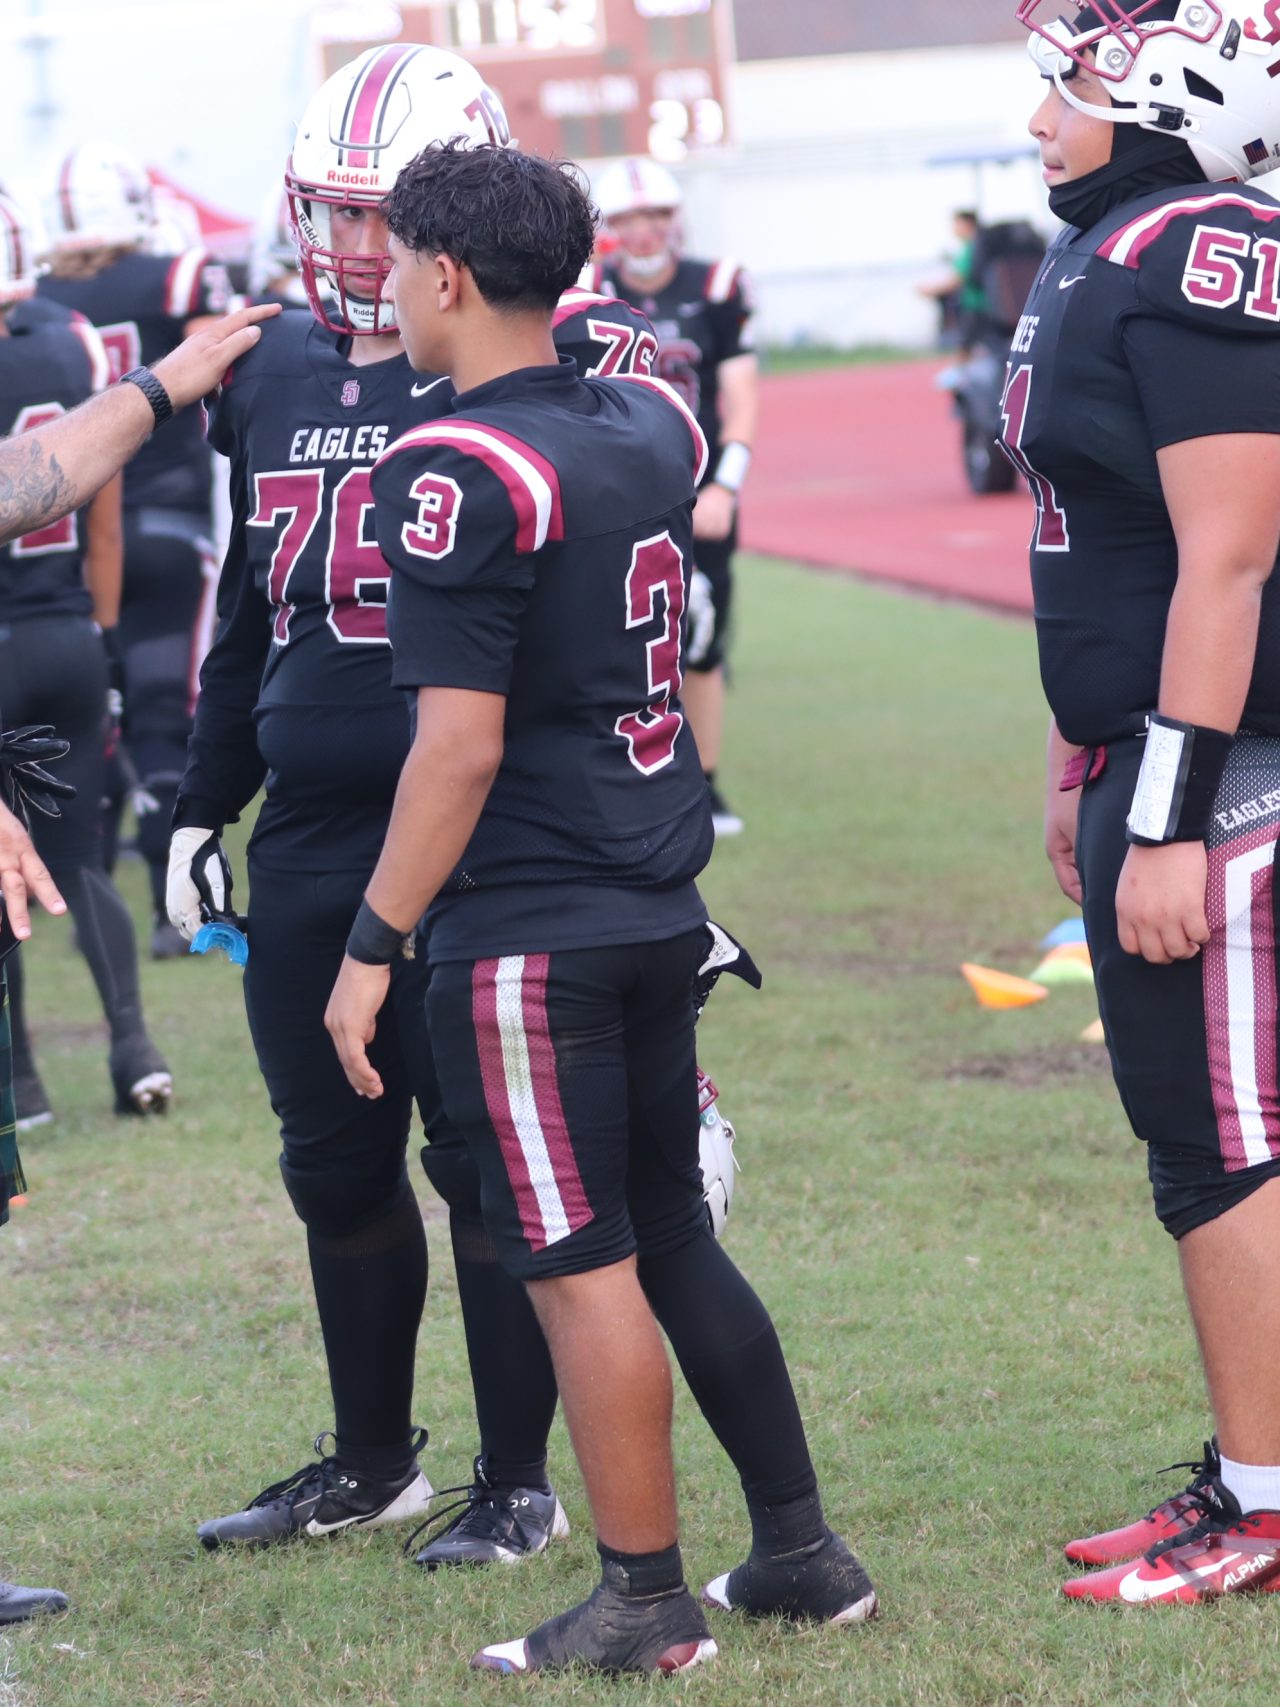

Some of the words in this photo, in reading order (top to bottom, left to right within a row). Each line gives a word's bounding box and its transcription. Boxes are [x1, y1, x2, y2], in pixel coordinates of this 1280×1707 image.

[327, 169, 380, 186] Riddell
[298, 212, 325, 250] Ridde
[1181, 224, 1280, 322] 51
[353, 307, 376, 317] Ridde
[584, 318, 658, 378] 76
[289, 425, 389, 462] EAGLES
[401, 472, 464, 561] 3
[245, 466, 394, 646] 76
[614, 529, 686, 776] 3
[1223, 1553, 1276, 1591] ALPHA
